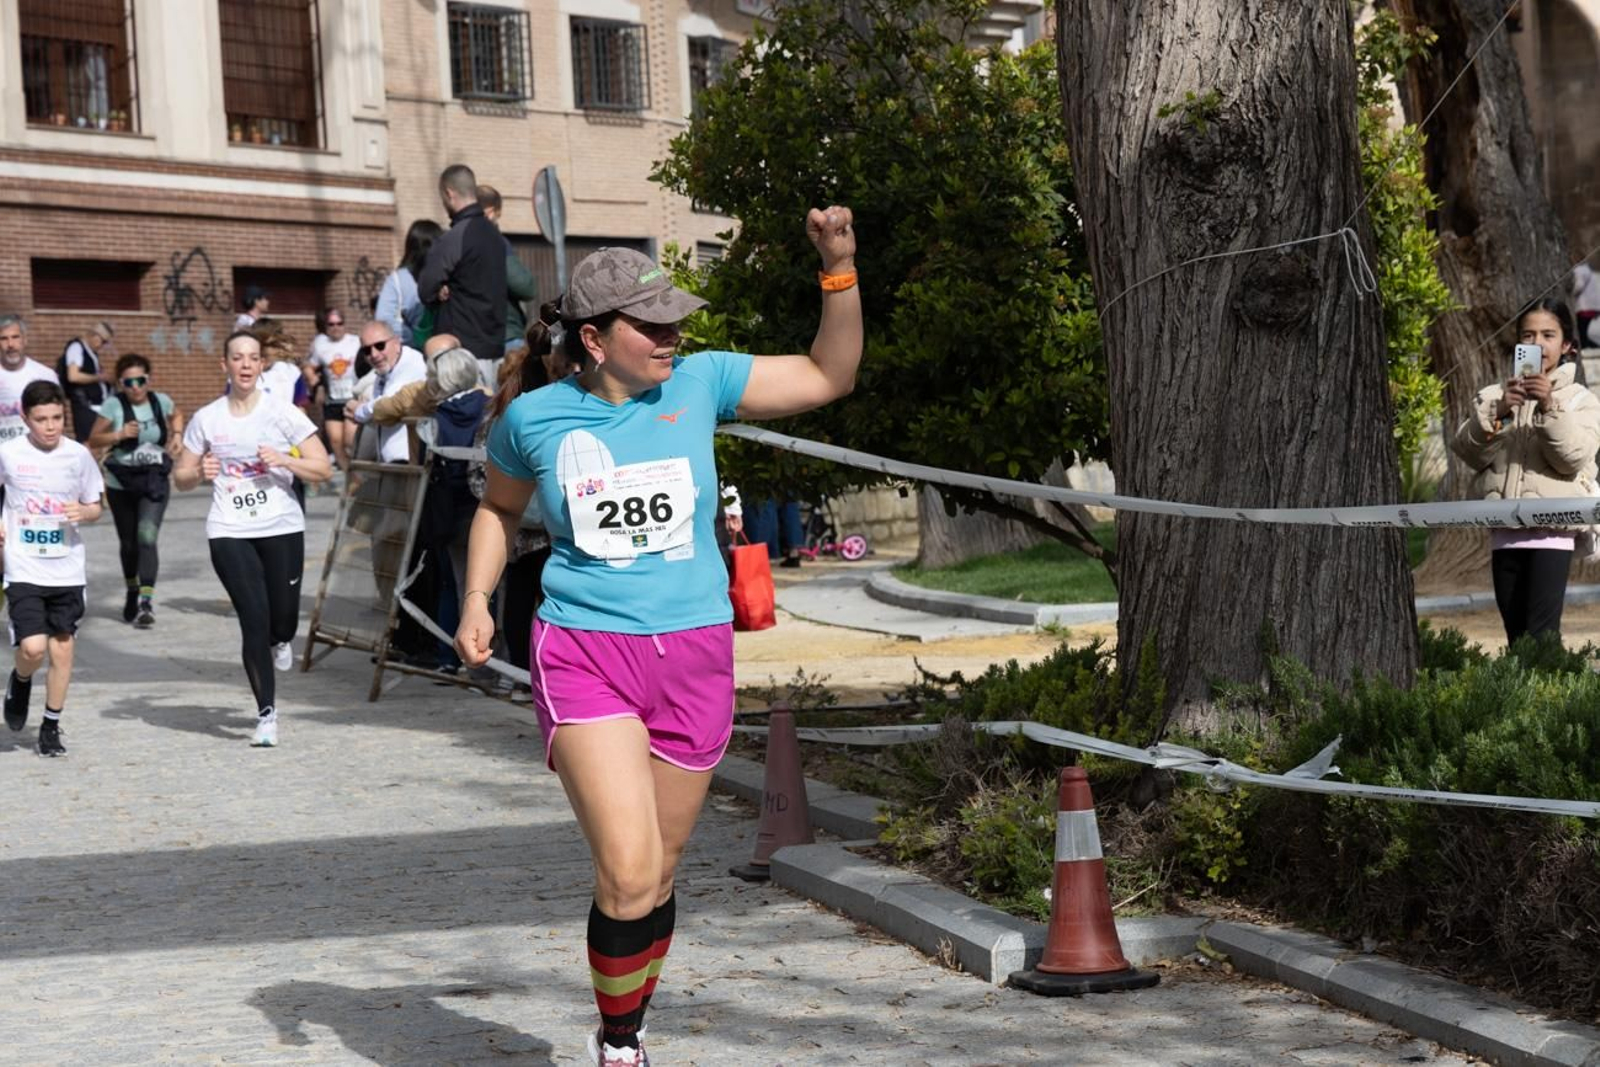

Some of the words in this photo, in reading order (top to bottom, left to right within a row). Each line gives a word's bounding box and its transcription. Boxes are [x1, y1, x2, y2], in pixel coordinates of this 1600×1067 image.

[233, 489, 267, 510] 969
[596, 493, 673, 529] 286
[1532, 511, 1585, 525] DEPORTES
[24, 529, 61, 544] 968
